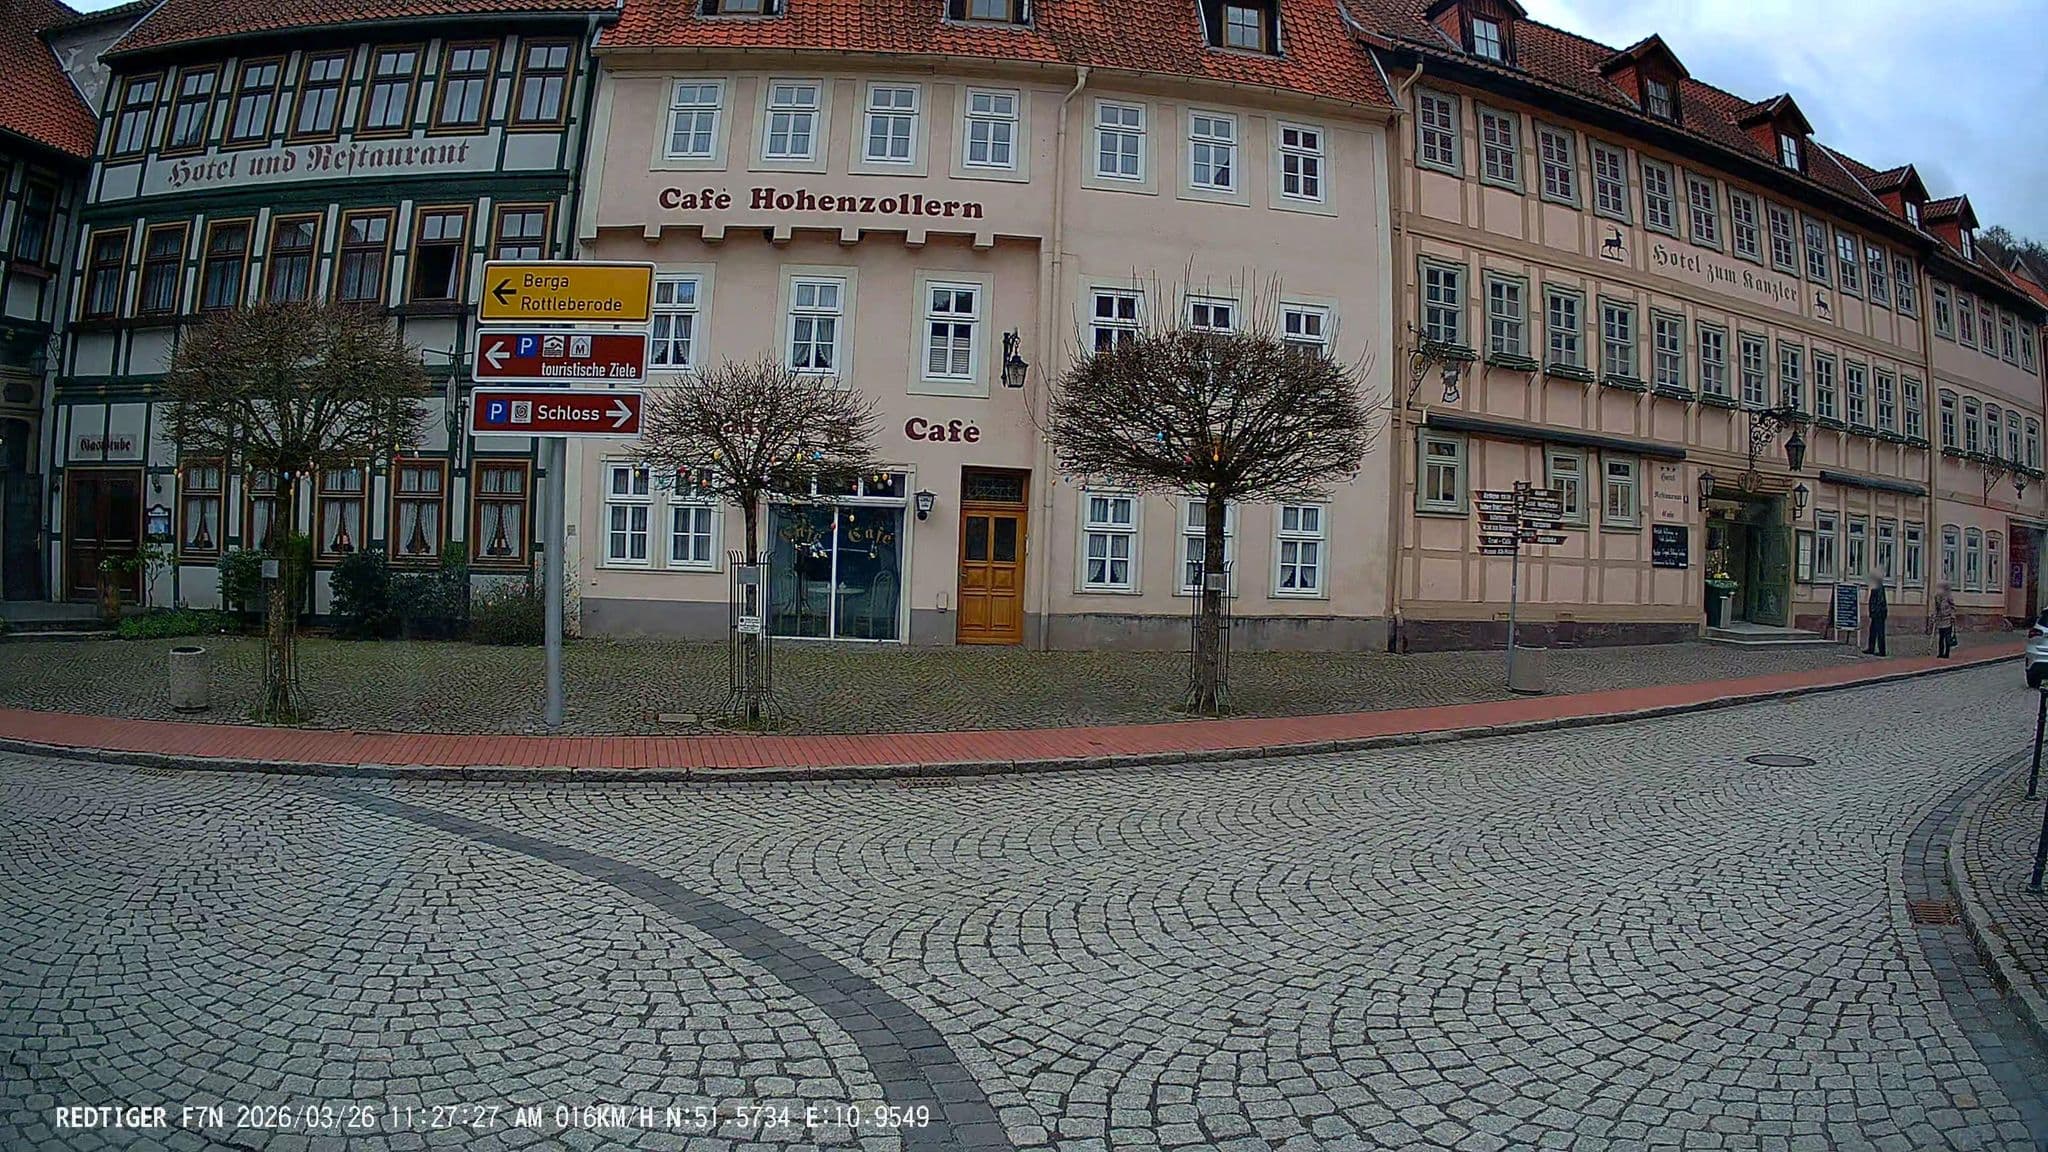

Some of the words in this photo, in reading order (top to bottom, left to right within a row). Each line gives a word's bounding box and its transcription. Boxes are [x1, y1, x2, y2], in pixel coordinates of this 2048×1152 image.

[169, 153, 238, 190] Hotel
[249, 149, 297, 177] und
[749, 187, 984, 218] Hohenzollern
[1652, 243, 1701, 274] Hotel
[1706, 263, 1738, 284] zum
[1742, 270, 1798, 302] Kanzler
[523, 273, 569, 291] Berga
[520, 296, 623, 312] Rottleberode
[541, 362, 606, 377] touristische
[609, 362, 636, 377] Ziele
[537, 404, 600, 421] Schloss
